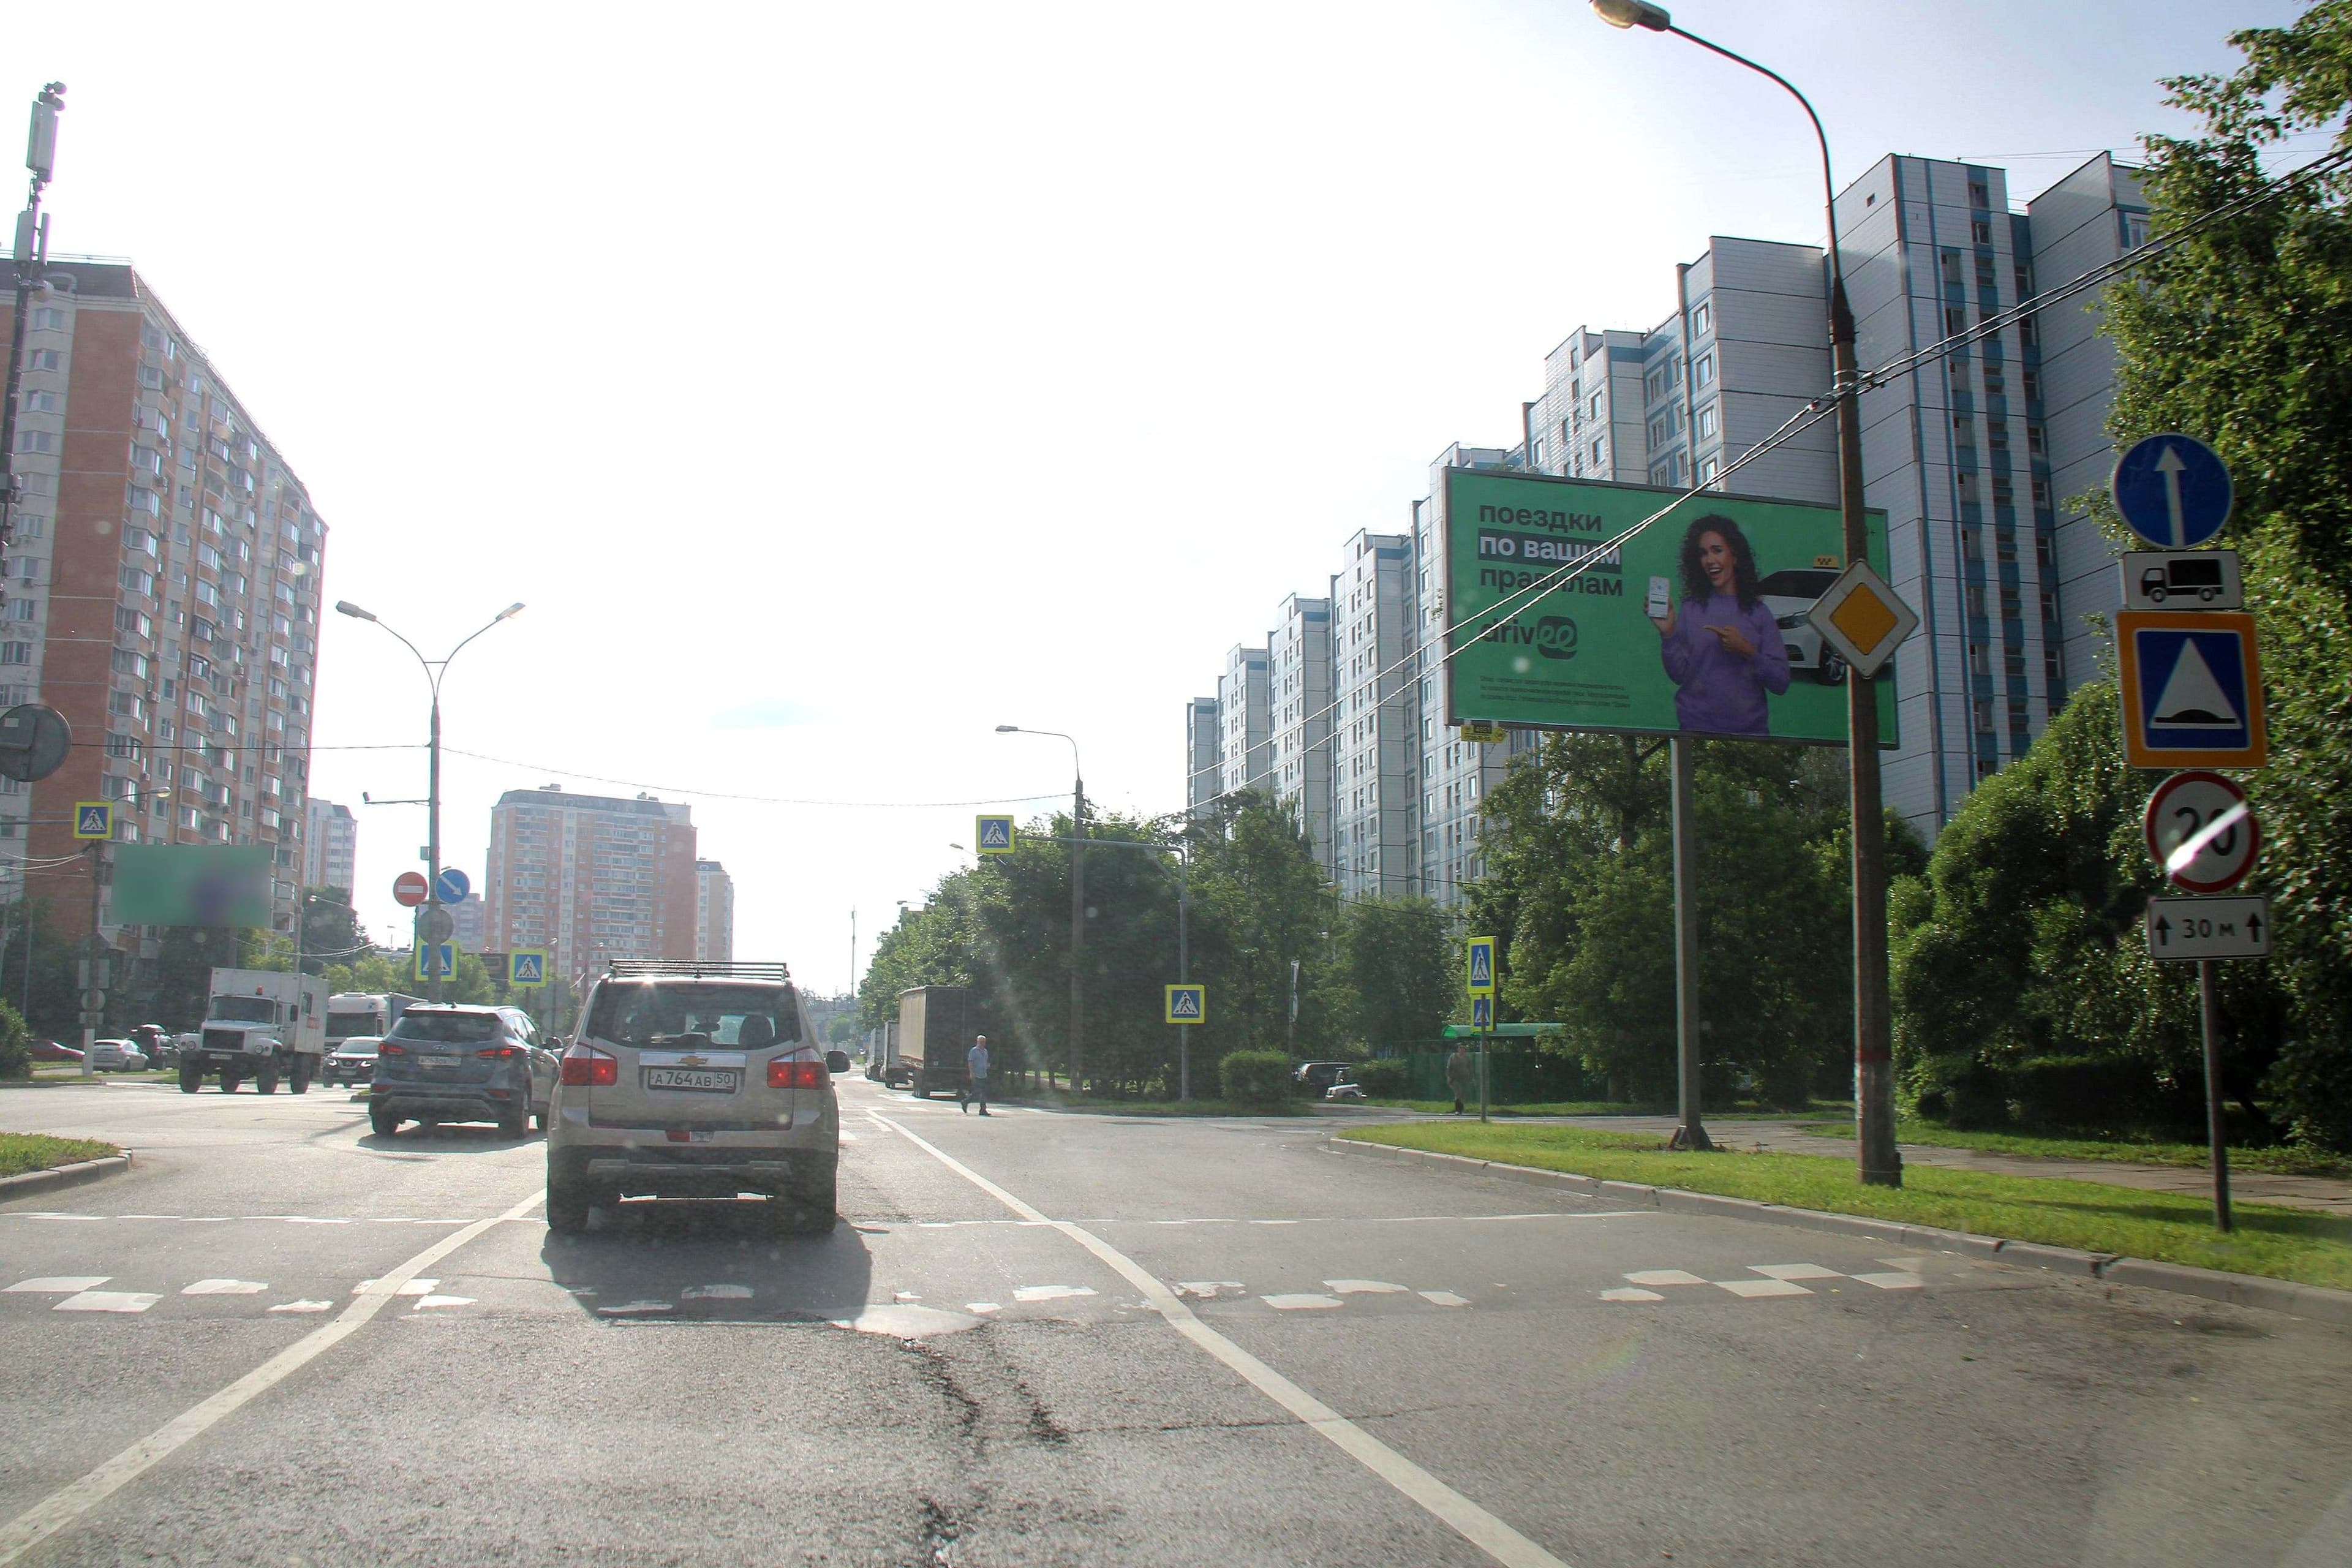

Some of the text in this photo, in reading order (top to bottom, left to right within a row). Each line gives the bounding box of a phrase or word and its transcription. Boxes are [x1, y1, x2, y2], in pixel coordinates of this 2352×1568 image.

[1479, 505, 1602, 533] поездки
[1480, 536, 1516, 556] по
[2174, 806, 2236, 856] 20
[2182, 919, 2212, 938] 30
